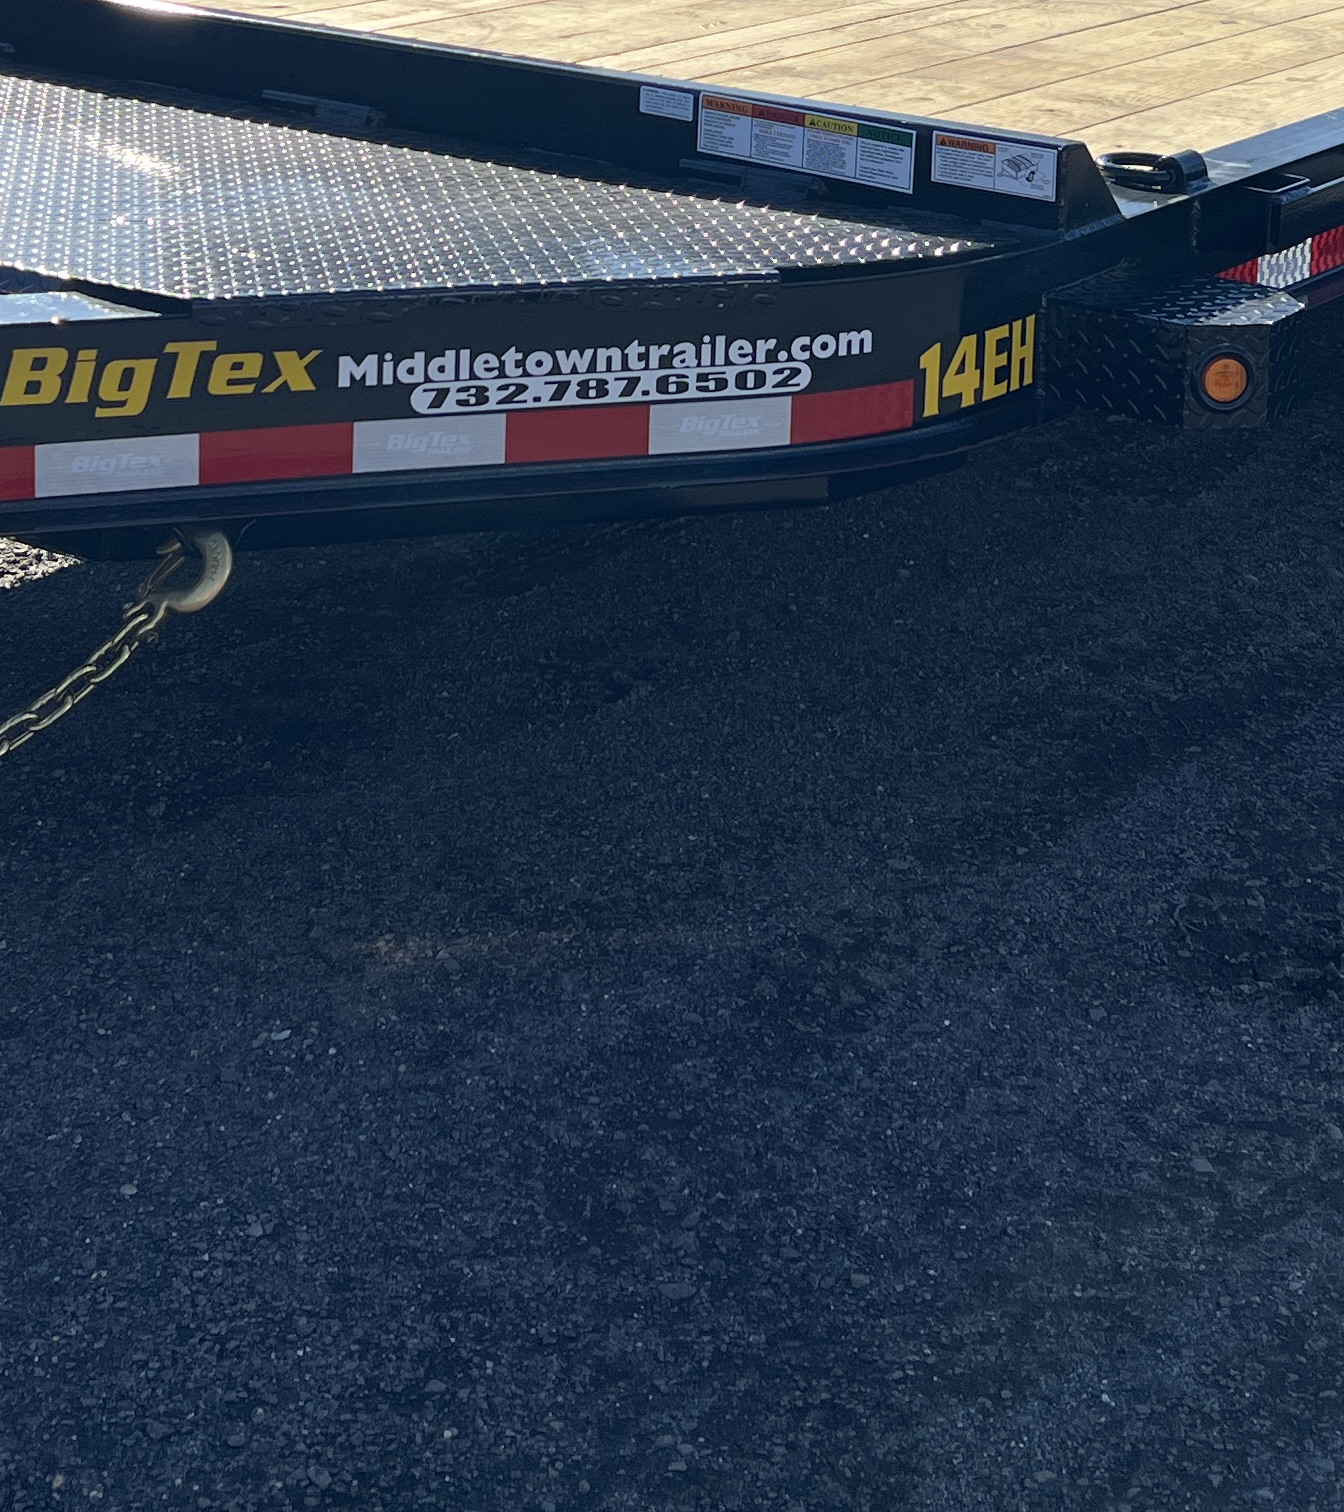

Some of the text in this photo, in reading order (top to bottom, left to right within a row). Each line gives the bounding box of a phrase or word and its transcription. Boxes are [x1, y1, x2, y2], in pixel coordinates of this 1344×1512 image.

[706, 98, 748, 114] WARNING
[816, 120, 854, 133] CAUTION
[948, 138, 989, 152] WARNING
[338, 327, 873, 387] Middletowntrailer.com
[919, 313, 1037, 417] 14EH
[422, 365, 805, 411] 732.787.6502
[680, 413, 762, 435] BigTex
[386, 430, 473, 453] BigTex
